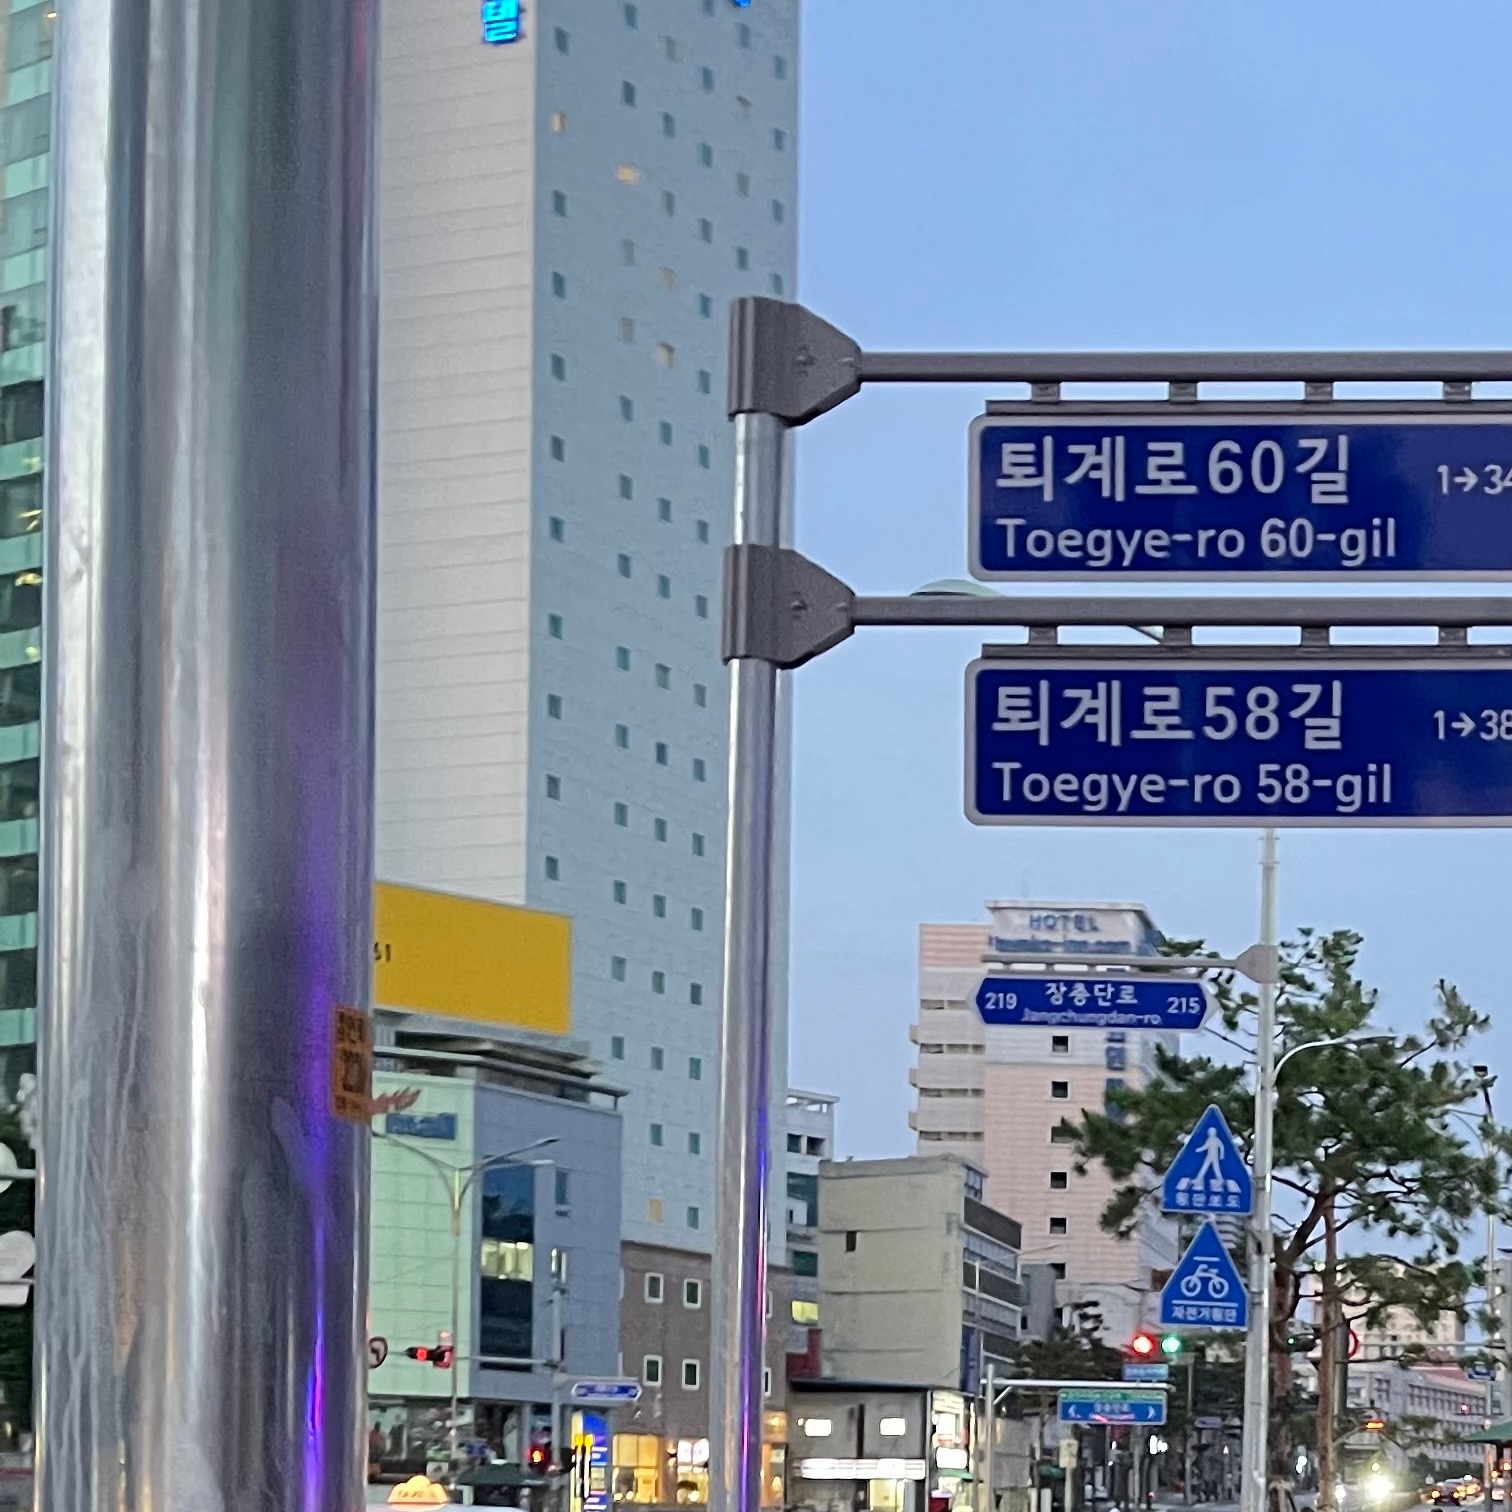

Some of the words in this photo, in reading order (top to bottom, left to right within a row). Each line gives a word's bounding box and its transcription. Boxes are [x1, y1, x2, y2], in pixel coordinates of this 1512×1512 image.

[996, 435, 1350, 505] 퇴계로60길
[997, 517, 1245, 566] Toegye-ro
[1260, 517, 1397, 565] 60-gil
[992, 680, 1344, 750] 퇴계로58길
[992, 761, 1241, 812] Toegye-ro
[1256, 763, 1392, 812] 58-gil
[984, 992, 1018, 1010] 219
[1045, 981, 1138, 1006] 장충단로
[1166, 996, 1200, 1014] 215
